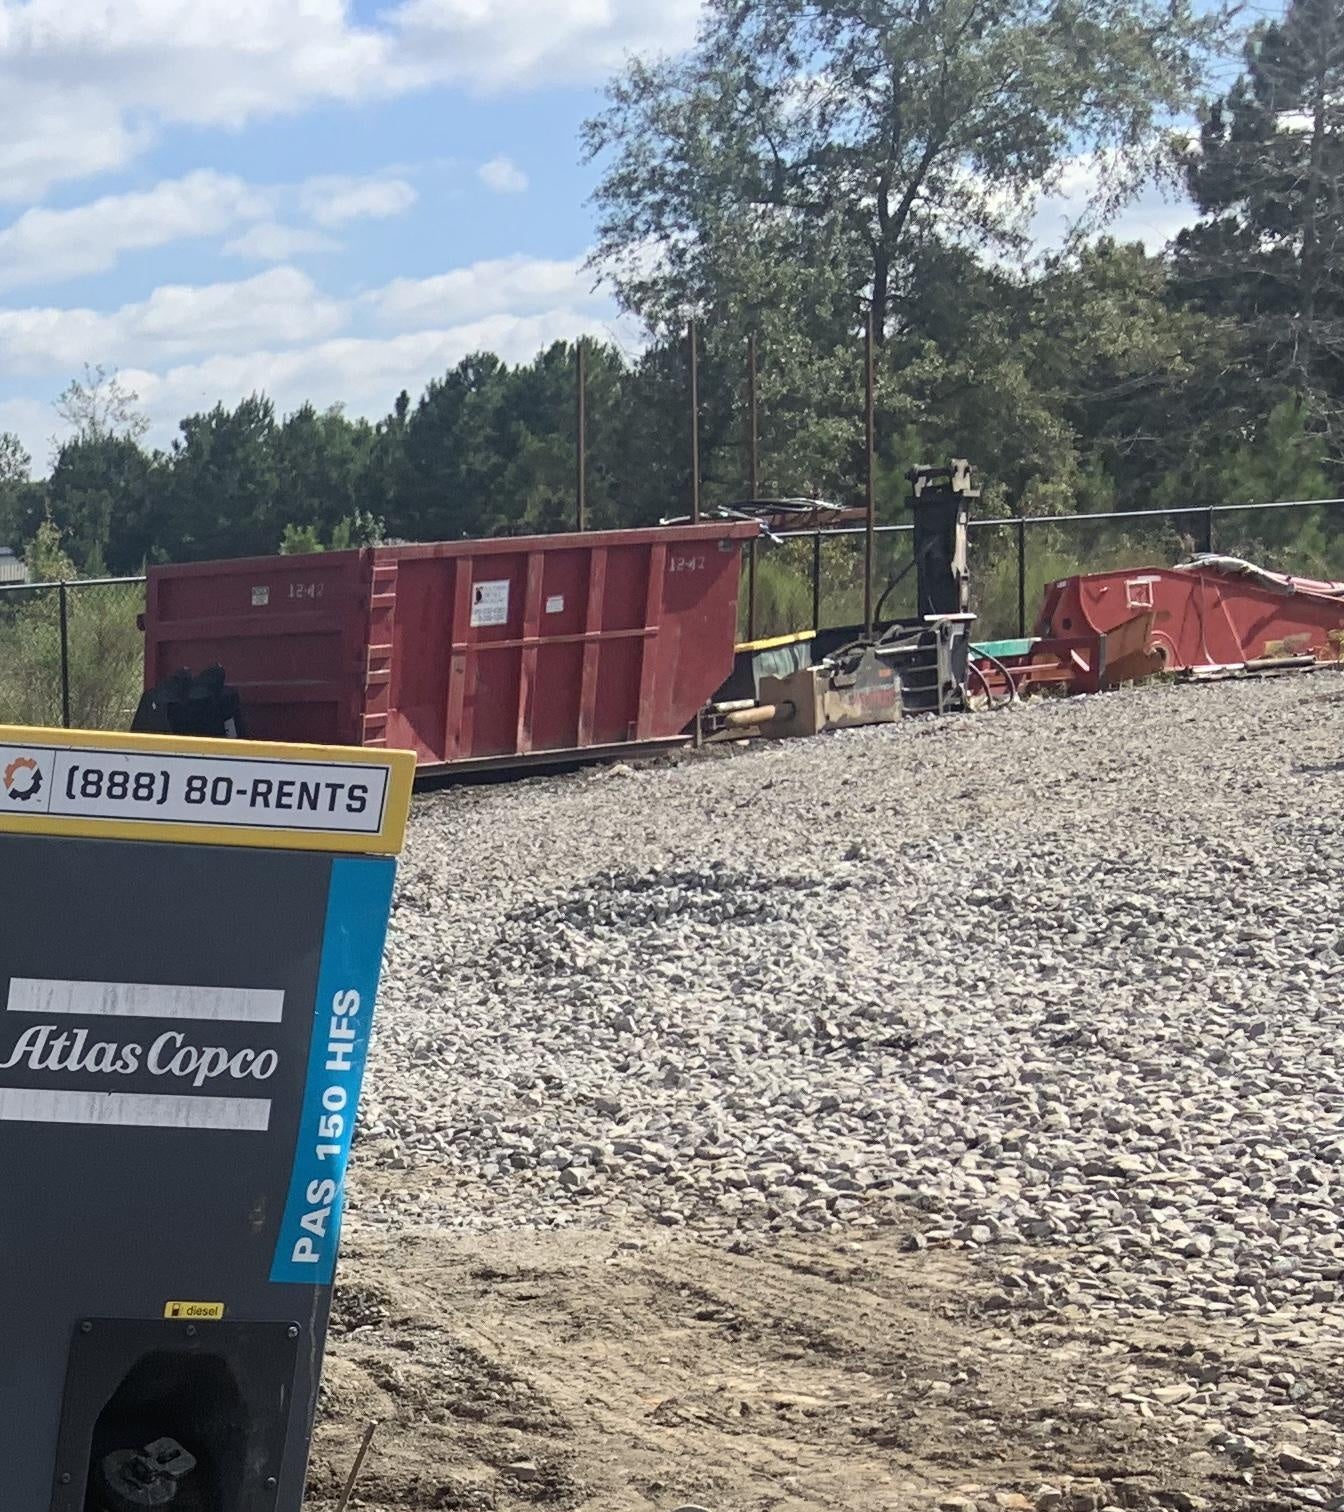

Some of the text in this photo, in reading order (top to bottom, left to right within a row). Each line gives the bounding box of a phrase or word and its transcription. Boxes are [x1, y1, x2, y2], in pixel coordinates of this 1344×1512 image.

[66, 765, 367, 813] (888) 80-RENTS
[147, 1030, 279, 1087] Copco
[291, 989, 361, 1264] PAS 150 HFS
[187, 1305, 219, 1316] diesel
